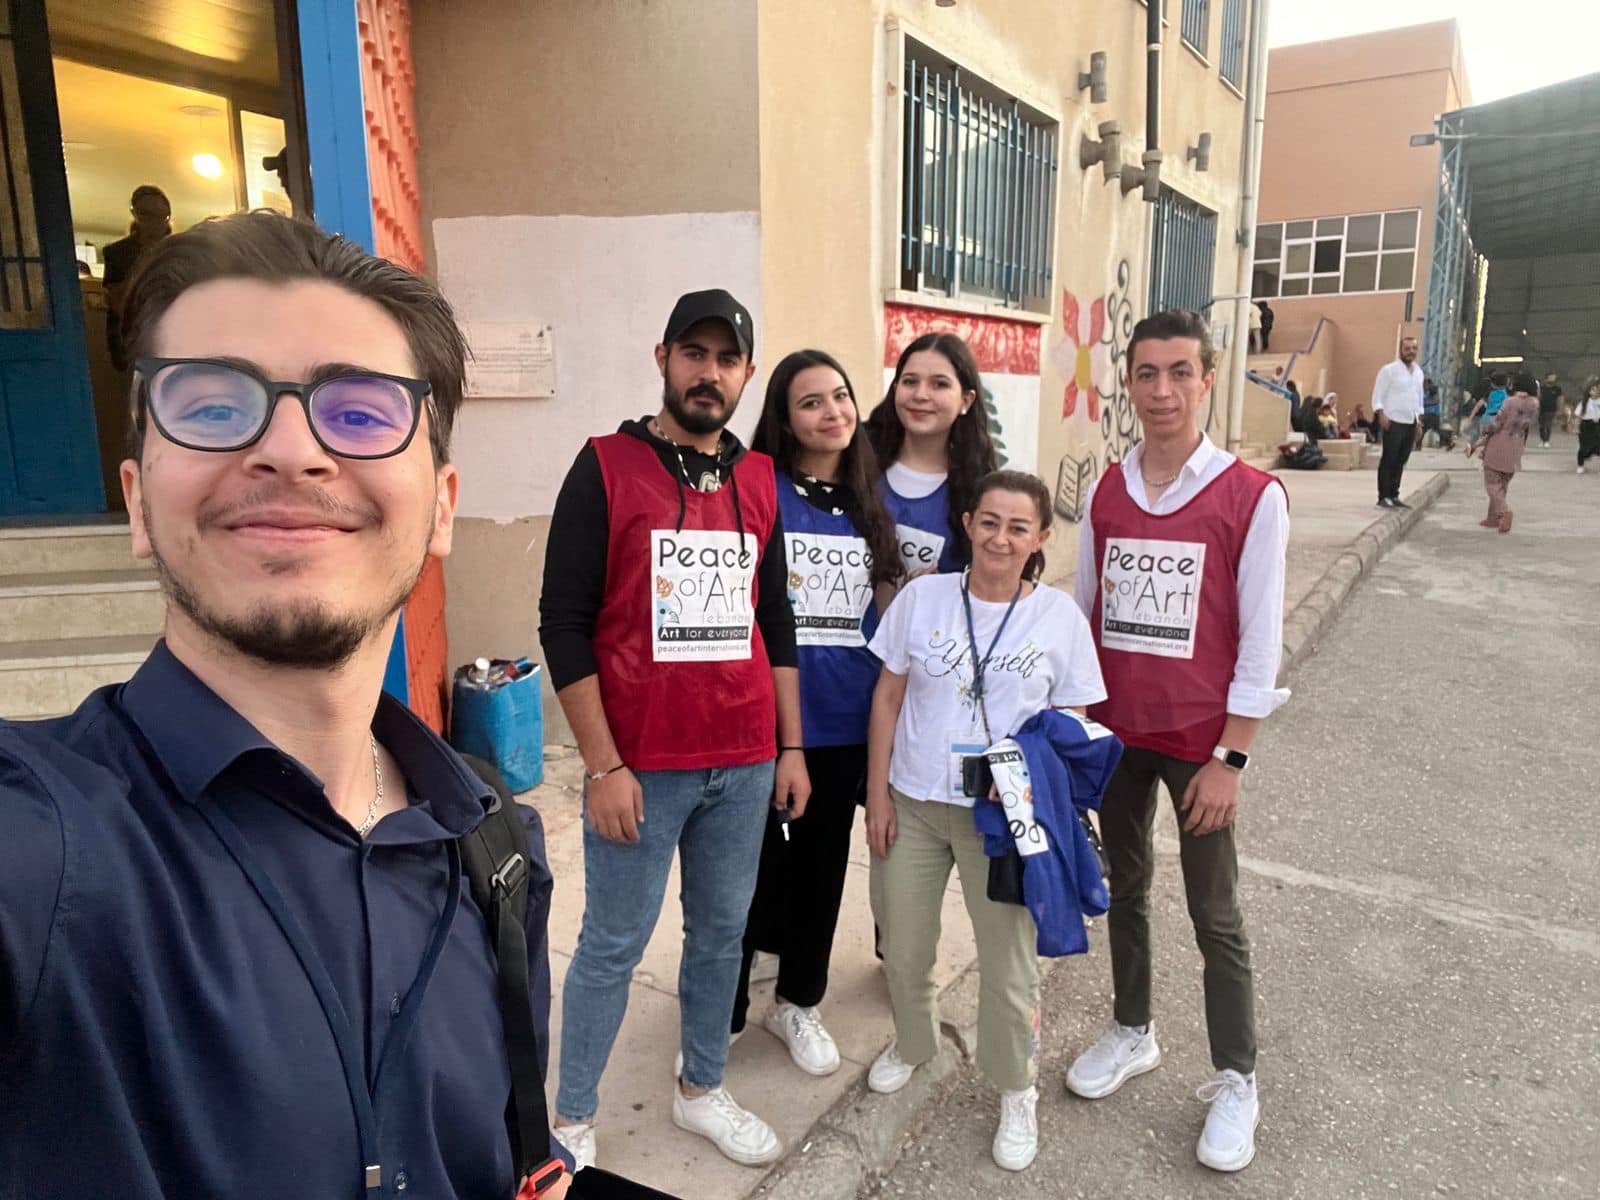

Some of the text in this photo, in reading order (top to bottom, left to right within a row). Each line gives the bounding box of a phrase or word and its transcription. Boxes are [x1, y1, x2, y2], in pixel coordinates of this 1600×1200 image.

[659, 538, 751, 569] Peace
[792, 539, 873, 569] Peace
[1107, 545, 1195, 576] Peace
[703, 570, 748, 613] Art
[826, 568, 873, 606] Art
[1134, 575, 1193, 616] Art
[660, 628, 680, 639] Art
[685, 628, 702, 639] for
[1134, 625, 1188, 639] everyone
